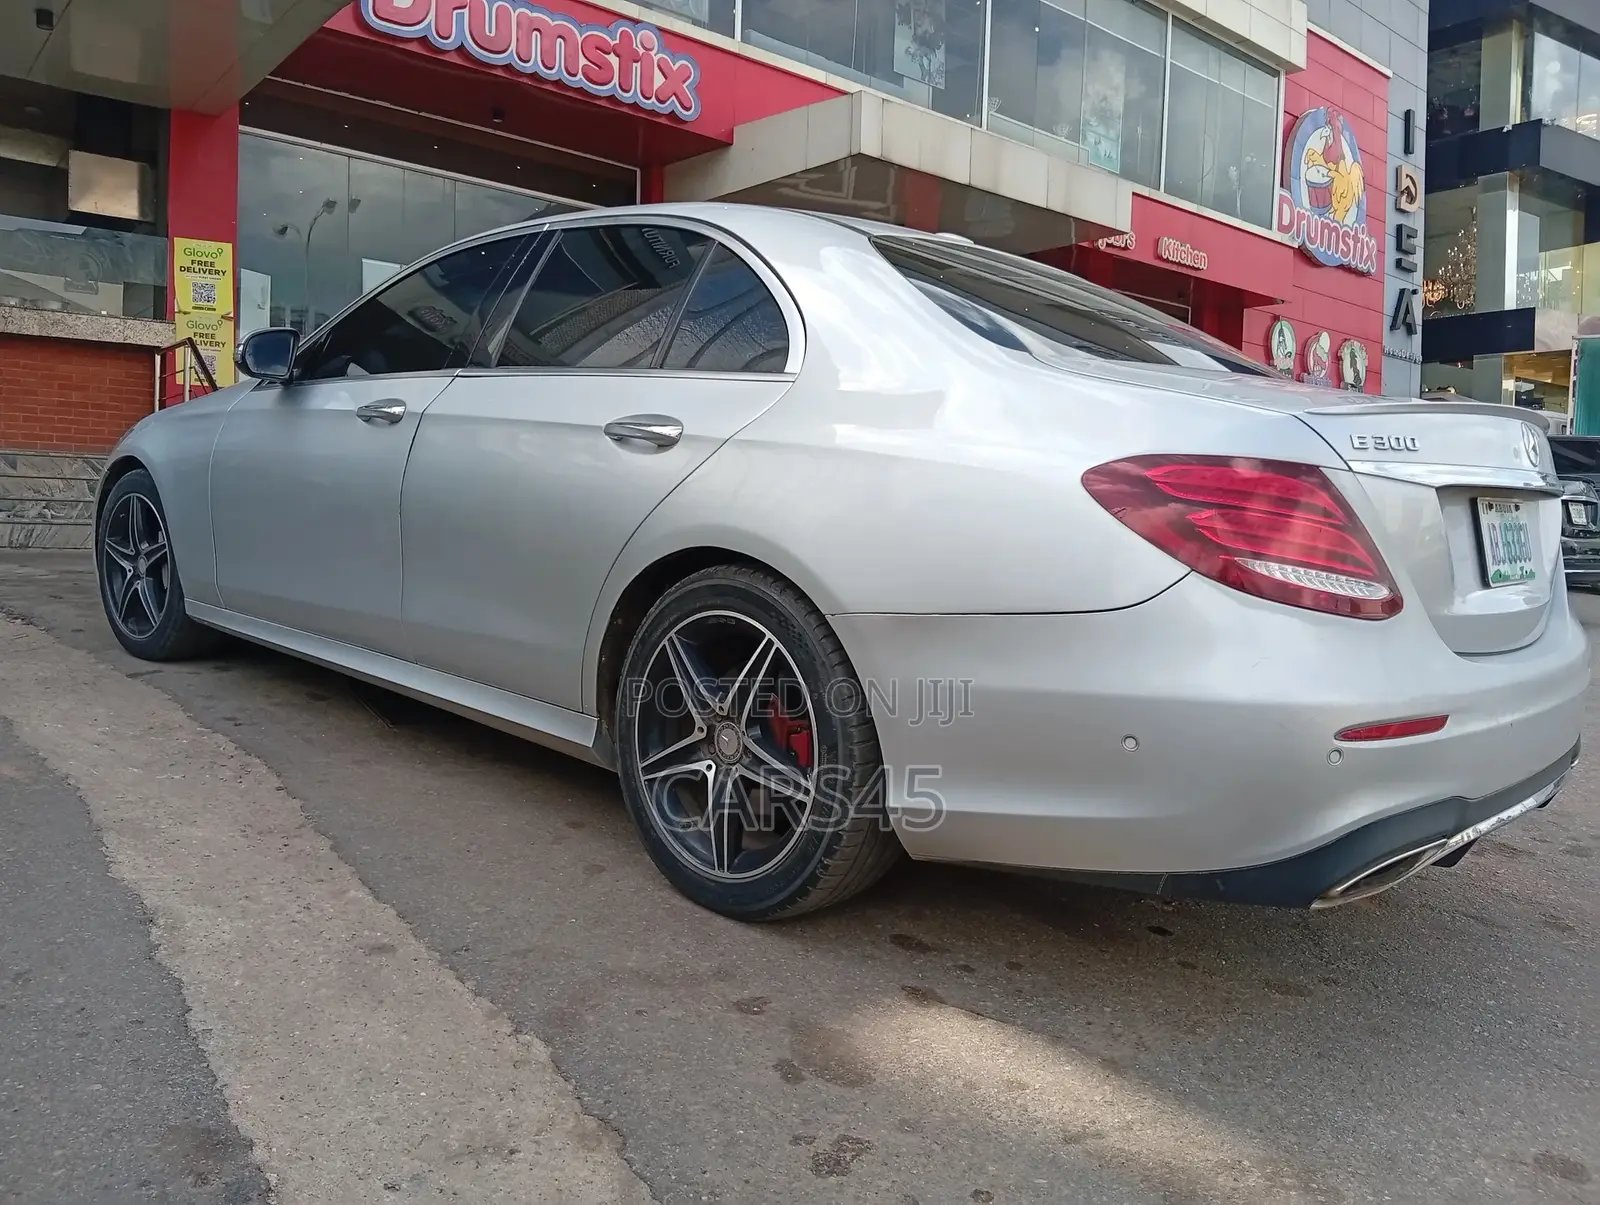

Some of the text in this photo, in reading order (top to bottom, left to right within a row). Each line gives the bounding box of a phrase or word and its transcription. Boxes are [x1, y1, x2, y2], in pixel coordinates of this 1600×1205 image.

[1277, 190, 1376, 273] Drumstix
[183, 247, 218, 259] Glovo
[1159, 236, 1208, 270] Kitchen
[191, 259, 215, 268] FREE
[179, 266, 227, 276] DELIVERY
[186, 320, 218, 331] Glovo
[193, 331, 216, 340] FREE
[195, 339, 227, 348] LIVERY
